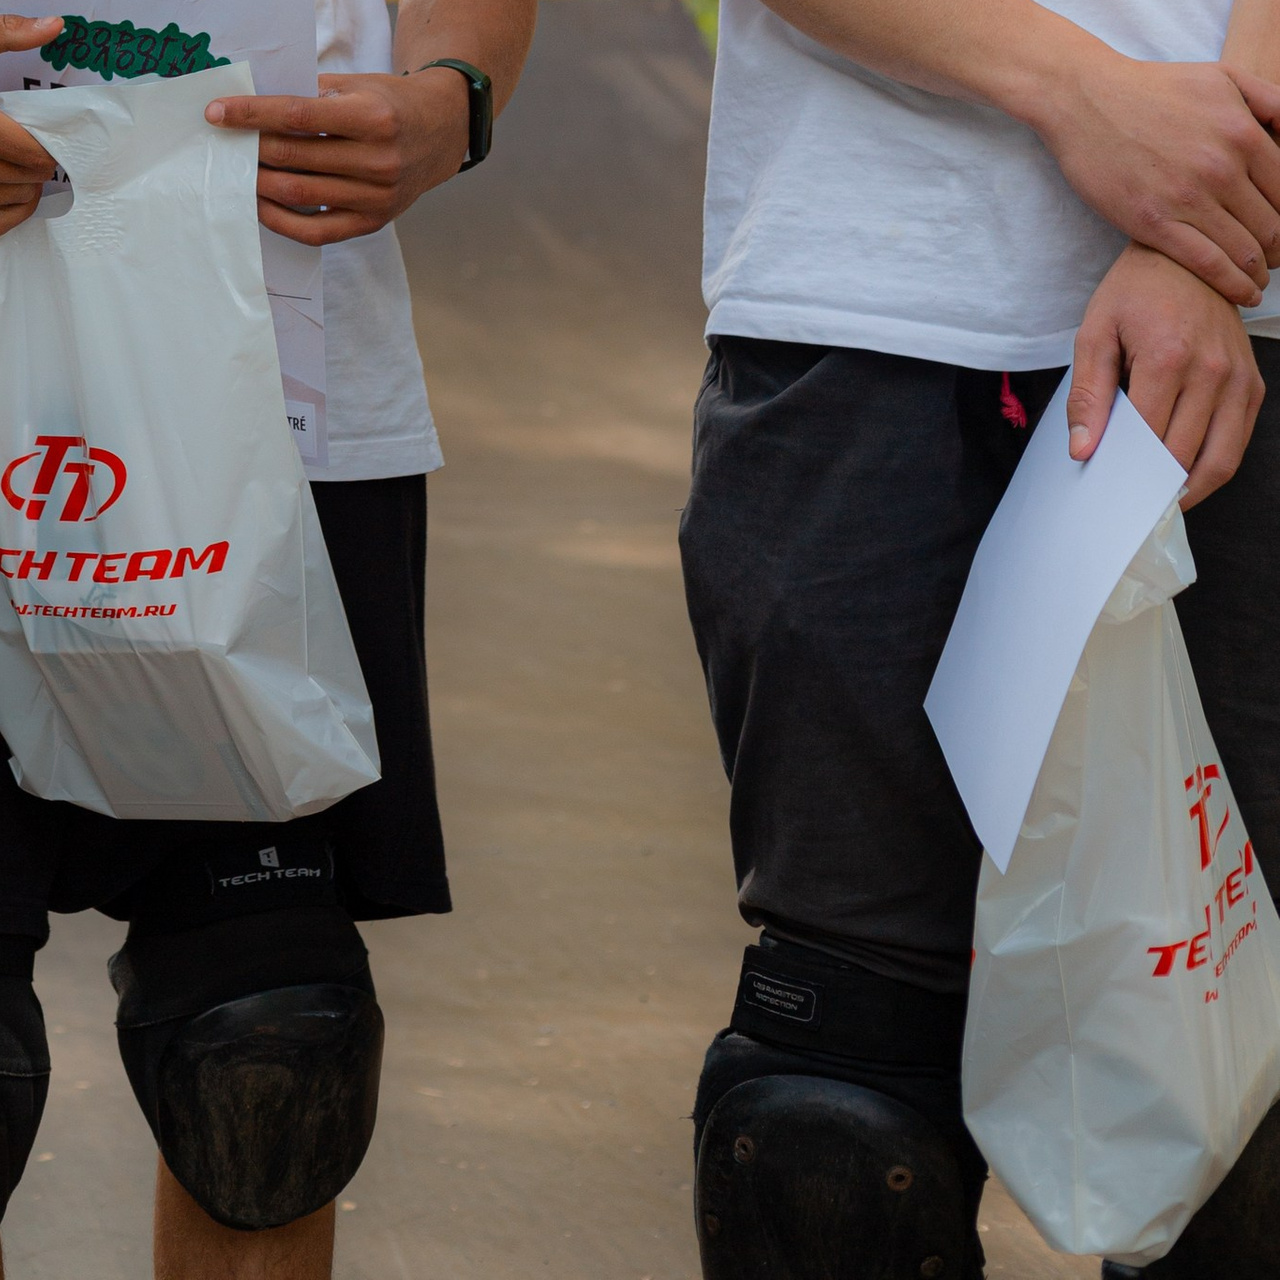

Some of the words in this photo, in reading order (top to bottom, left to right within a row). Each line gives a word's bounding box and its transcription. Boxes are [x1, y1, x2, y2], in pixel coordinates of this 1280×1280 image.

[66, 540, 230, 584] TEAM
[219, 871, 270, 888] TECH
[273, 867, 321, 879] TEAM
